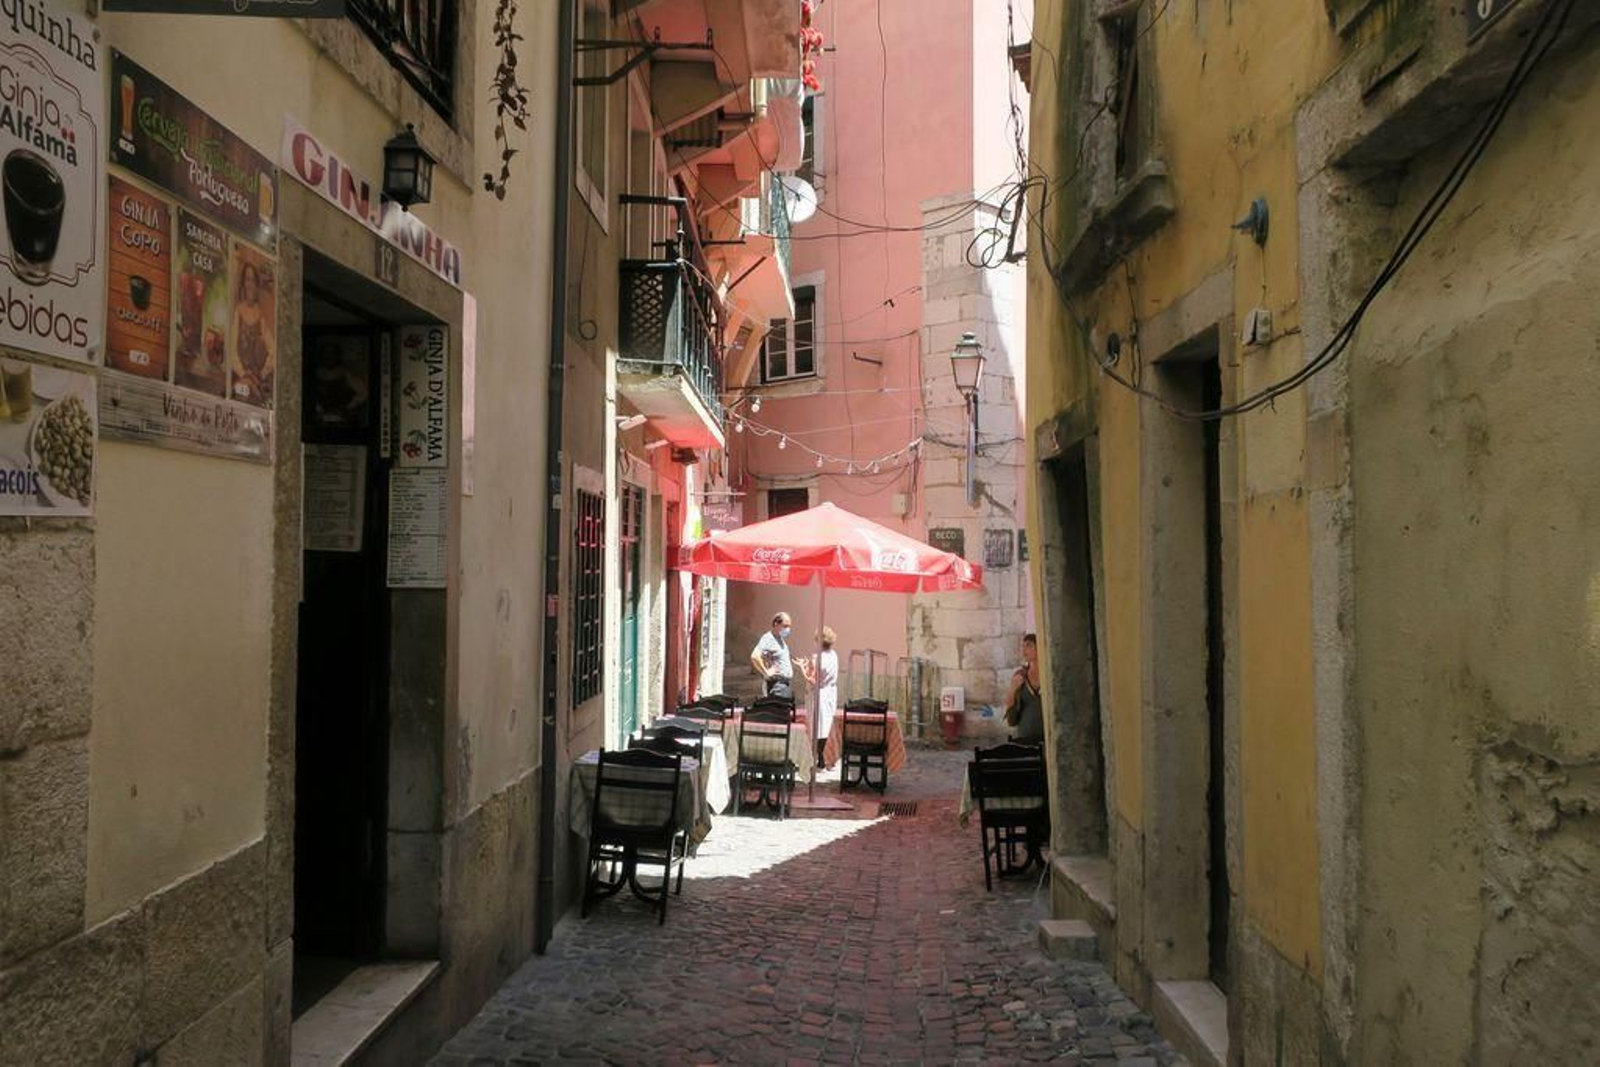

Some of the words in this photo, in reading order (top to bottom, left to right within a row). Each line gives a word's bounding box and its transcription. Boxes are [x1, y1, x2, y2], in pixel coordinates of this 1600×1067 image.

[0, 65, 60, 128] Ginja
[0, 104, 78, 167] Alfama
[121, 195, 159, 229] GINJA
[292, 132, 460, 284] GINJNHA
[186, 222, 221, 250] SANGRIA
[425, 328, 443, 376] GINJA
[162, 393, 197, 423] Vinho
[427, 381, 443, 461] D'ALFAMA
